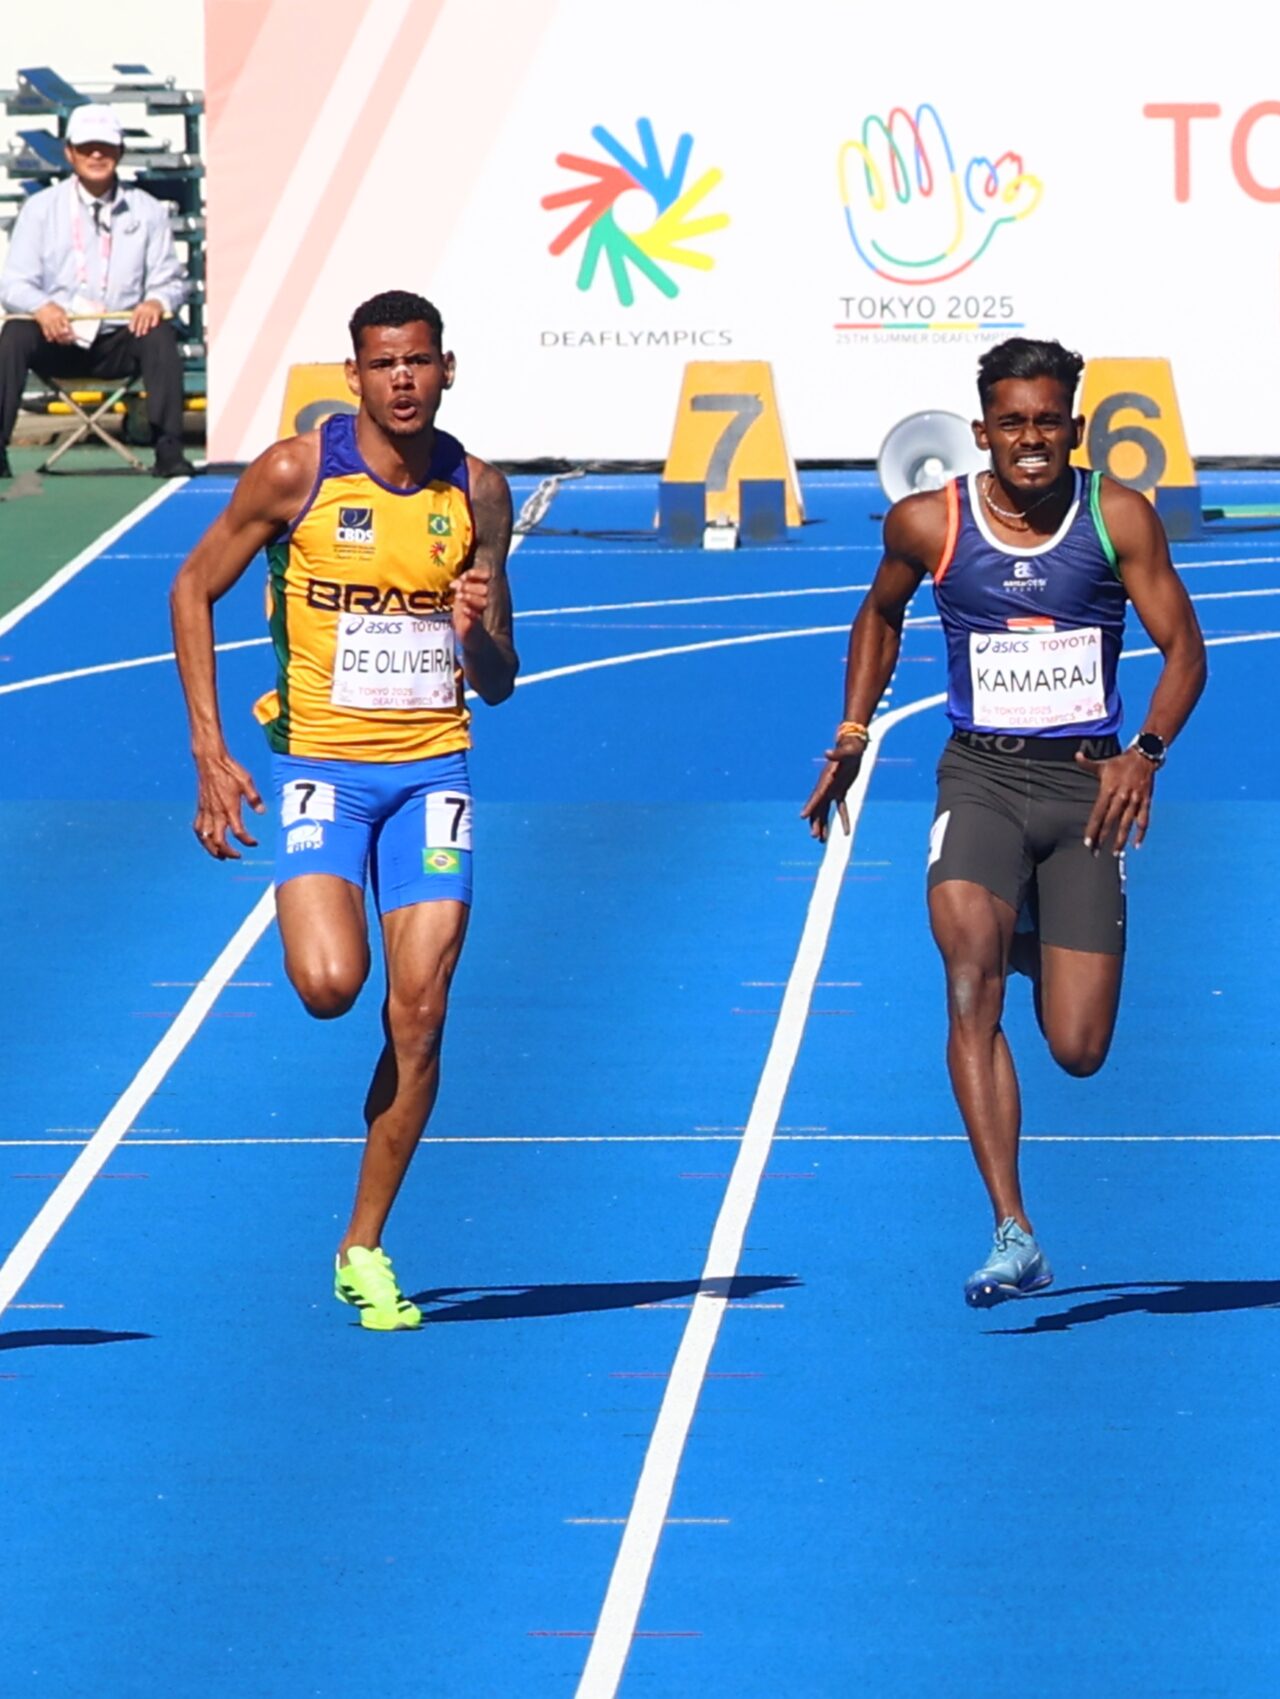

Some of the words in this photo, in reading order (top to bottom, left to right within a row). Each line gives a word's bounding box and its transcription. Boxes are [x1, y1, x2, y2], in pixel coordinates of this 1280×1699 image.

[840, 295, 936, 320] TOKYO
[947, 295, 1014, 320] 2025
[541, 330, 733, 347] DEAFLYMPICS
[873, 332, 929, 345] SUMMER
[690, 393, 764, 491] 7
[1088, 392, 1167, 492] 6
[991, 640, 1030, 653] asics
[1040, 634, 1097, 651] TOYOTA
[342, 648, 370, 672] DE
[375, 647, 452, 674] OLIVEIRA
[976, 660, 1097, 693] KAMARAJ
[295, 783, 316, 815] 7
[445, 797, 466, 842] 7
